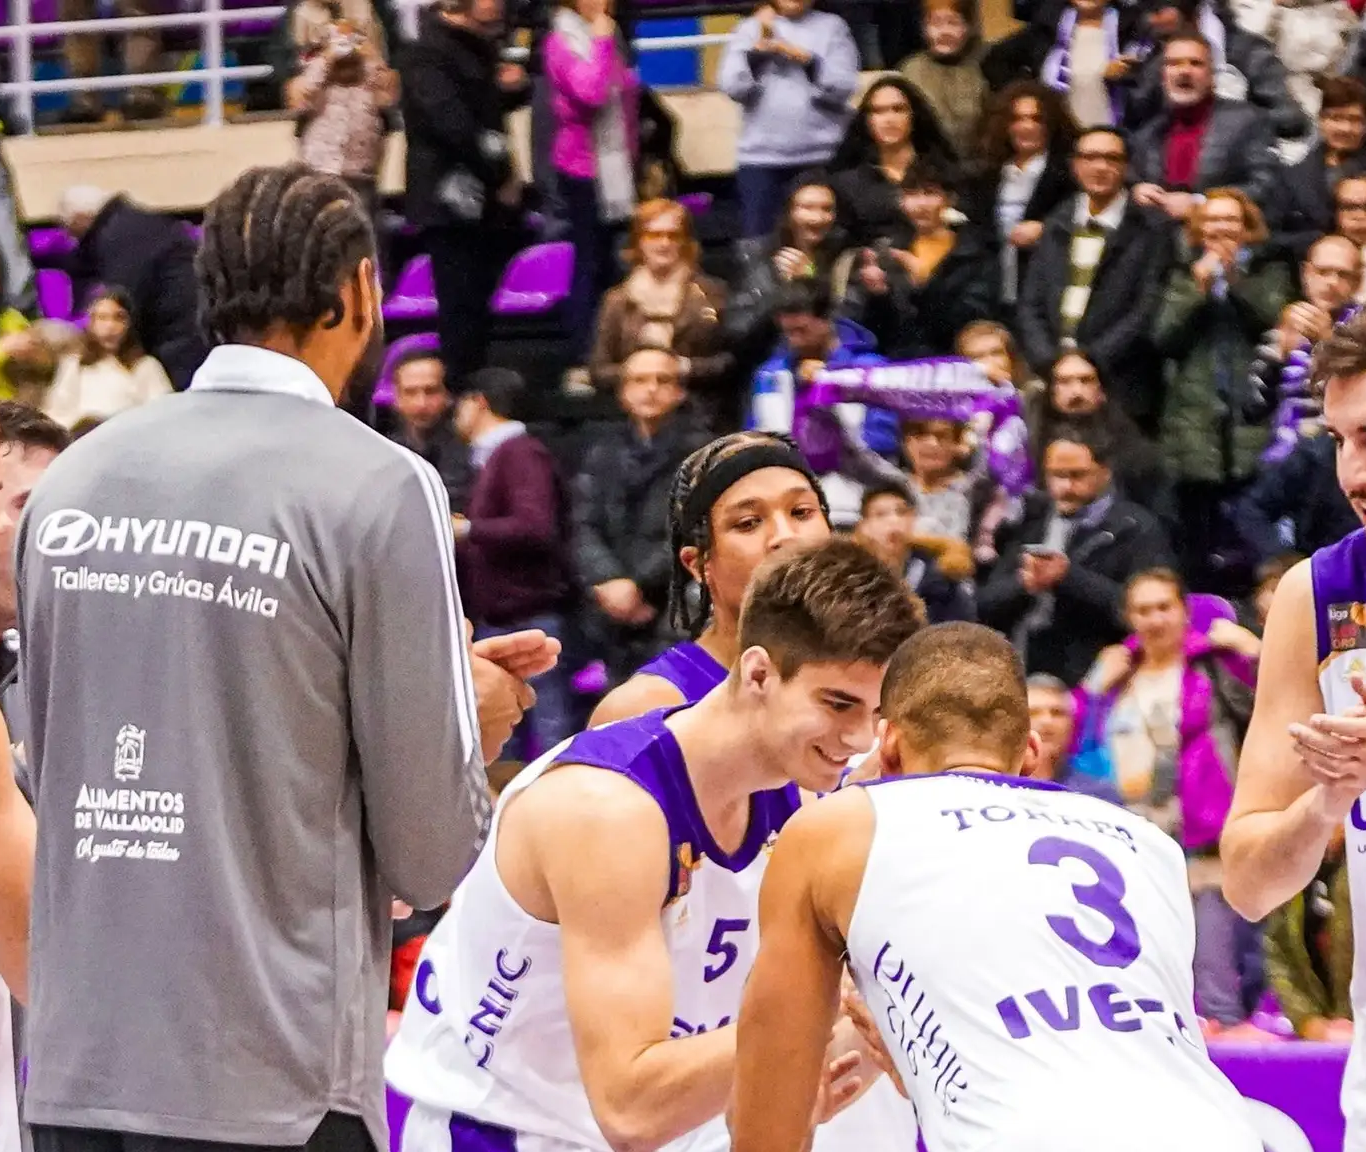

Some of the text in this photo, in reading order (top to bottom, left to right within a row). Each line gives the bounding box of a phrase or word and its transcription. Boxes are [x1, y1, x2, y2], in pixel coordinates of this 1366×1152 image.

[96, 516, 291, 579] HYUNDAI
[51, 566, 280, 618] Talleres y Grúas Ávila
[75, 783, 185, 814] ALIMENTOS
[75, 809, 185, 834] DE VALLADOLID
[1028, 835, 1142, 969] 3
[703, 918, 751, 983] 5
